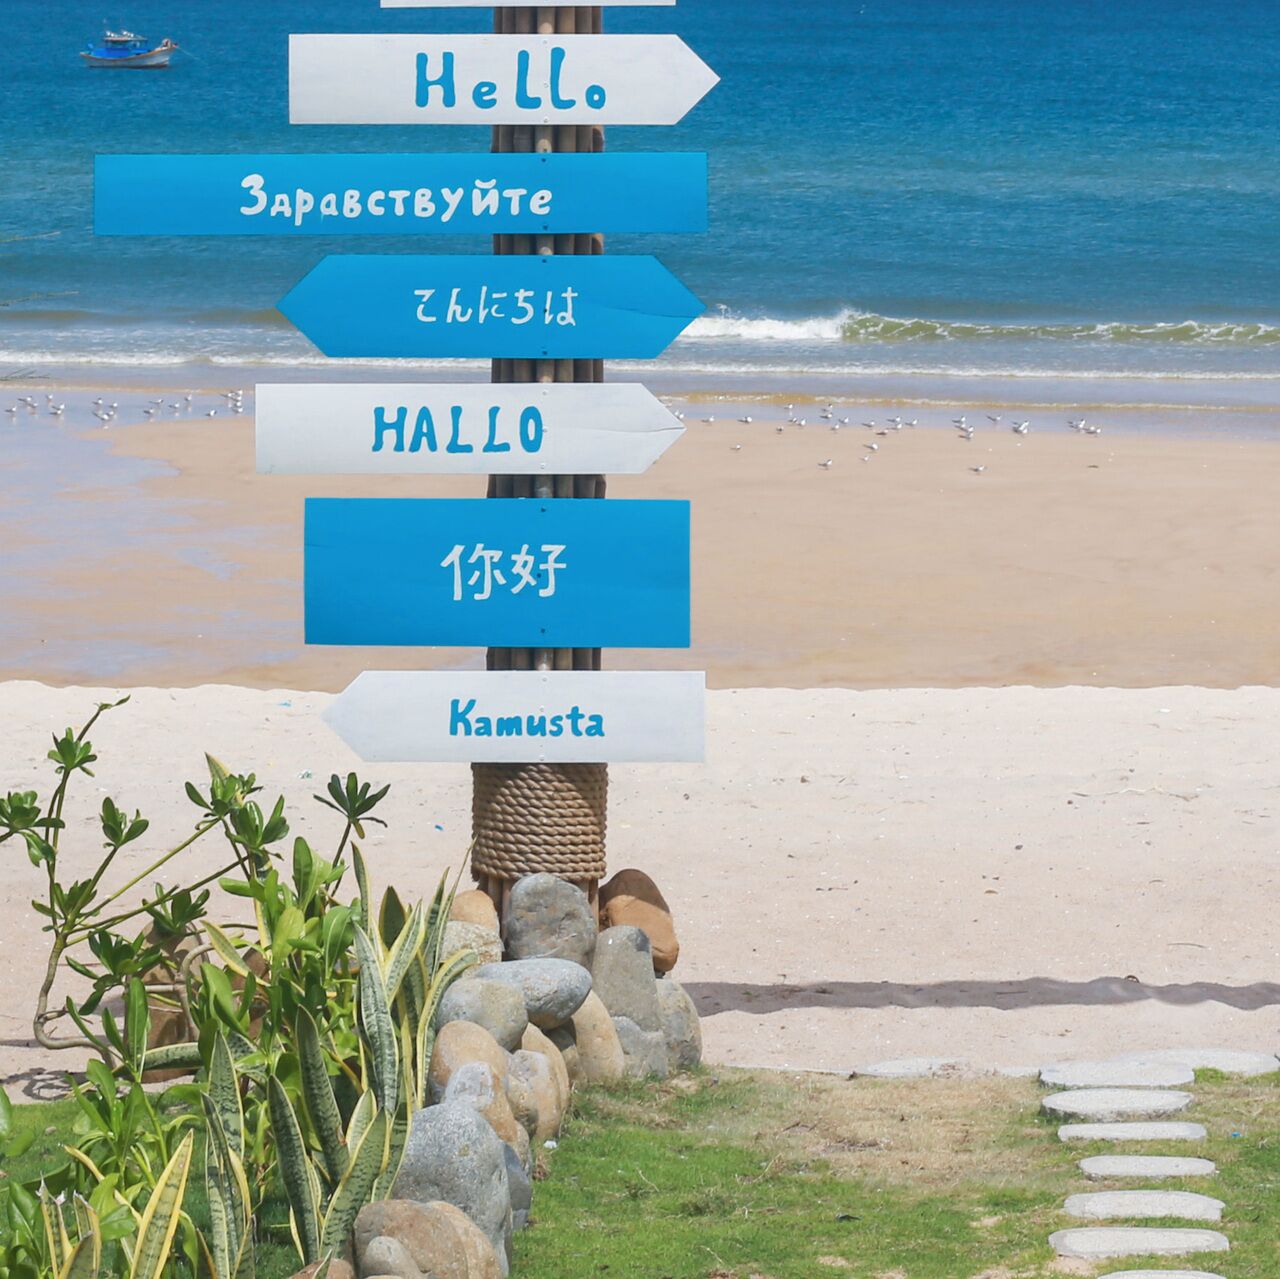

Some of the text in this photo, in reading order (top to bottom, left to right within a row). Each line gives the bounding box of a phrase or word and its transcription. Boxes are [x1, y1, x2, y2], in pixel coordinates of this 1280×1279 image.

[241, 174, 552, 226] Здравствуйте
[371, 405, 544, 454] HALLO
[440, 543, 567, 601] 你好
[449, 698, 605, 738] Kamusta
